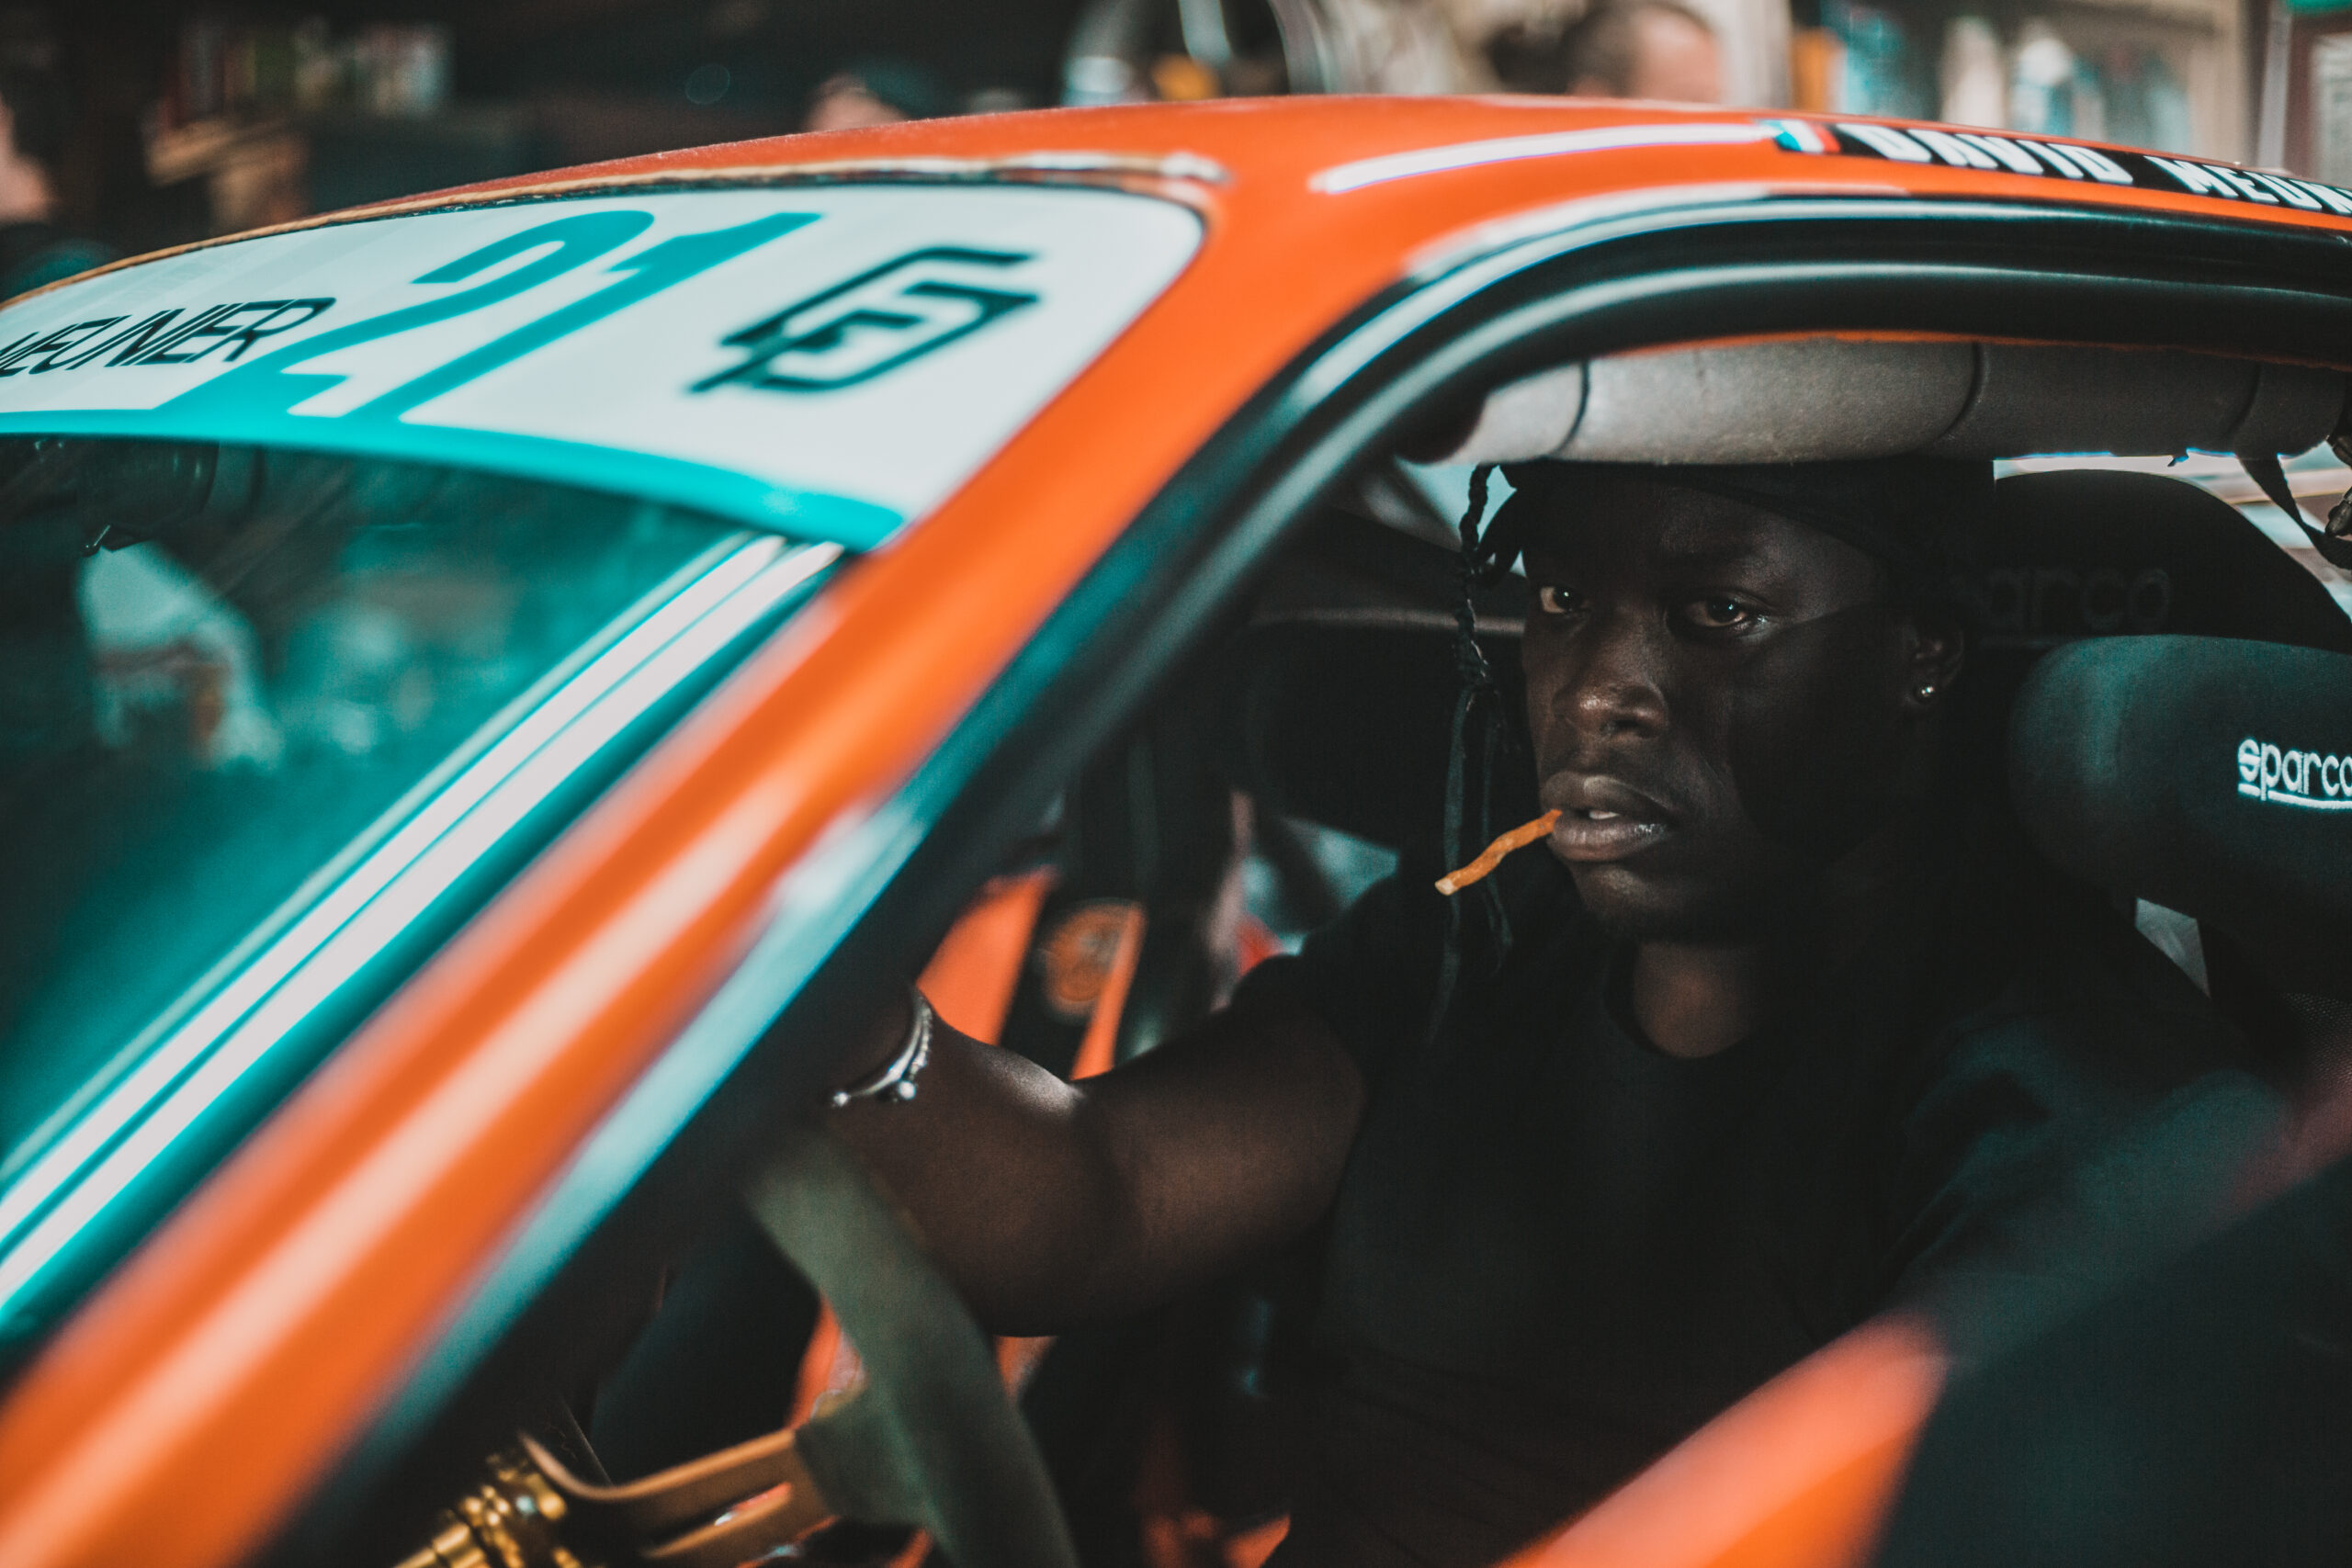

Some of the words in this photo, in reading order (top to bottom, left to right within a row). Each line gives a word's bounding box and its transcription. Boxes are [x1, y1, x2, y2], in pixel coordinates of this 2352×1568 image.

[1836, 122, 2134, 185] DAVID
[152, 209, 823, 424] 21
[1980, 565, 2173, 634] arco
